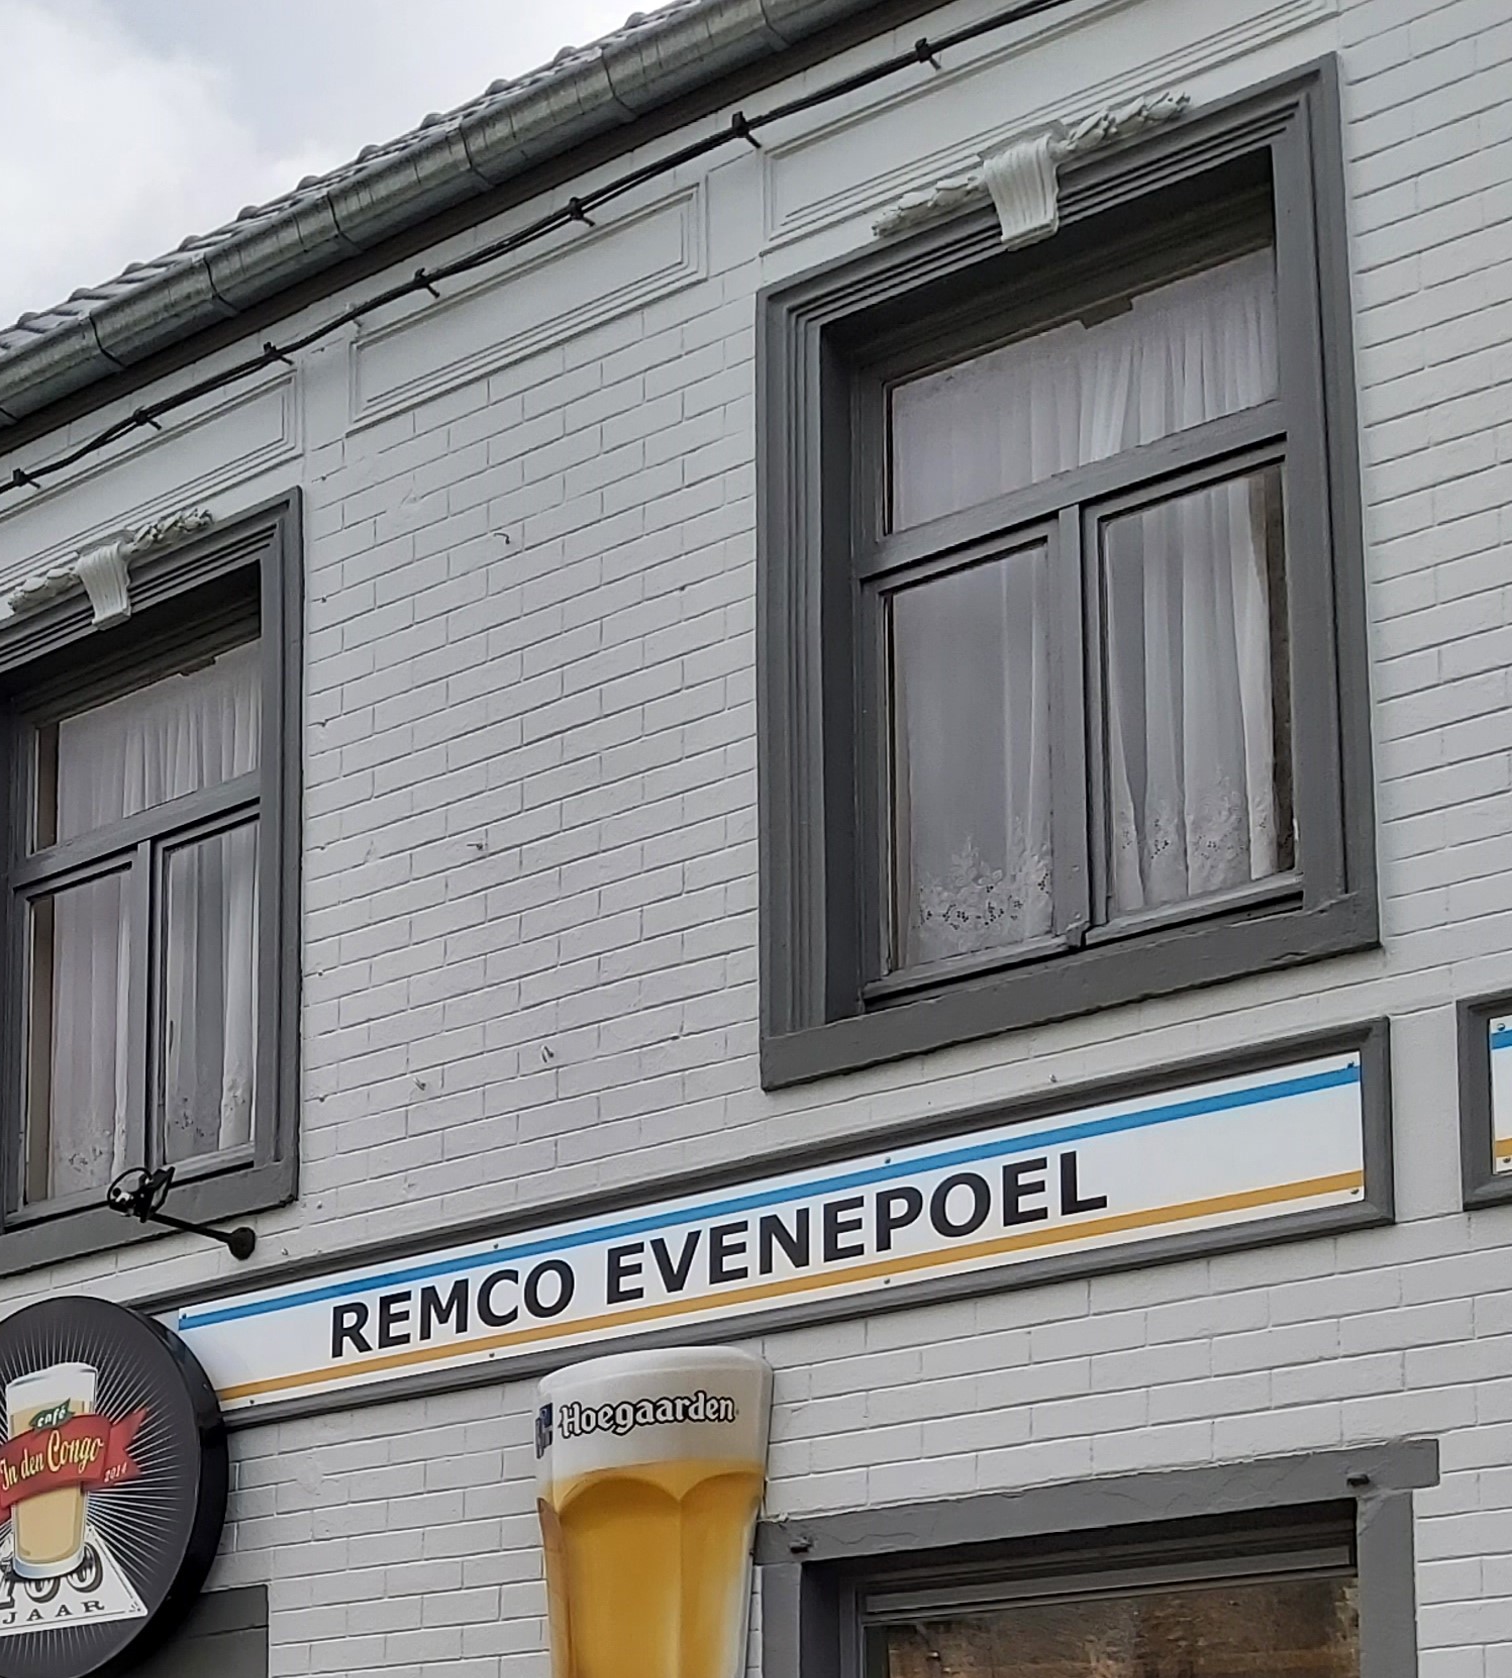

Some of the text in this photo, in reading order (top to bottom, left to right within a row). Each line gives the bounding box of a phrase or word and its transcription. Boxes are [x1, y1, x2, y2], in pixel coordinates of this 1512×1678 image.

[330, 1149, 1109, 1359] REMCO EVENEPOEL
[37, 1405, 67, 1428] café
[559, 1390, 736, 1439] Hoegaarden
[0, 1429, 104, 1491] In den Congo
[104, 1461, 128, 1483] 2014
[2, 1600, 105, 1625] JAAR
